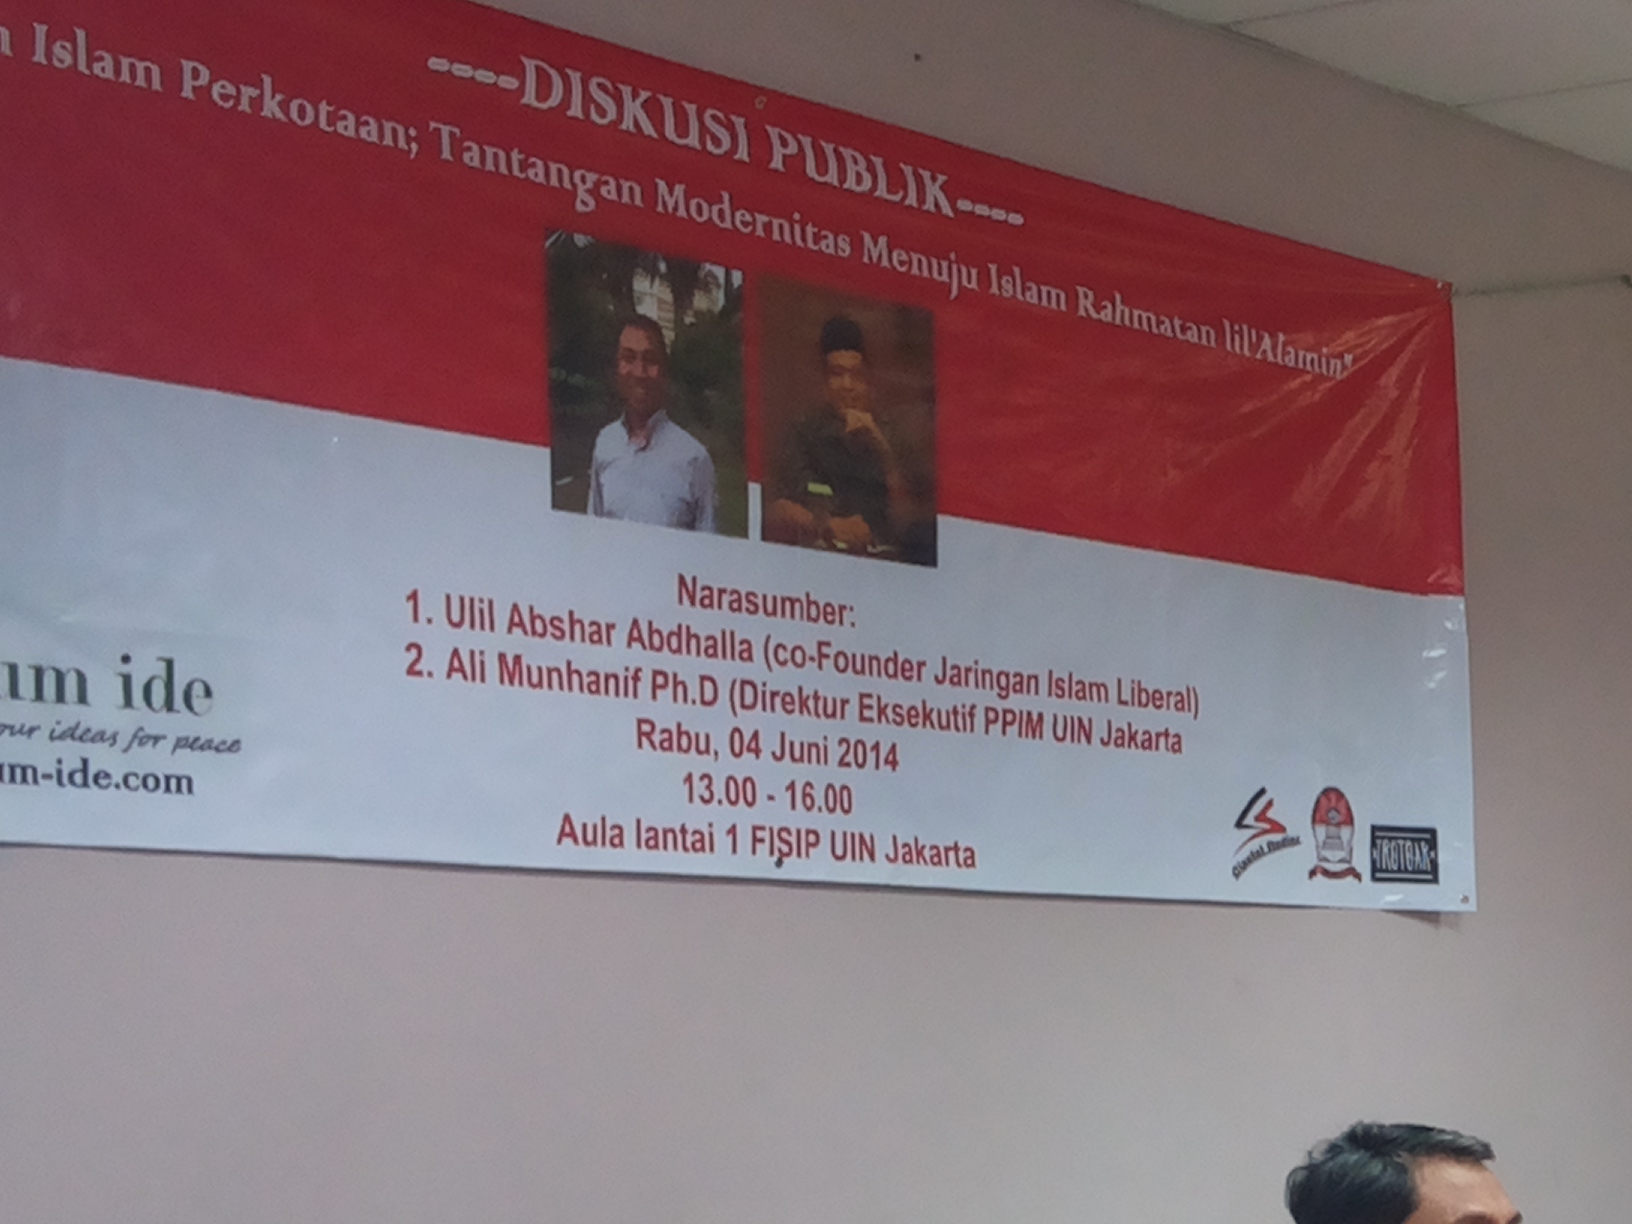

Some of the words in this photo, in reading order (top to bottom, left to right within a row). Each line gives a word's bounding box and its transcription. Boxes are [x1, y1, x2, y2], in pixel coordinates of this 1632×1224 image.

[31, 22, 163, 92] Islam
[180, 58, 419, 157] Perkotaan;
[428, 121, 643, 212] Tantangan
[656, 178, 851, 259] Modernitas
[861, 230, 979, 300] Menuju
[988, 262, 1067, 313] Islam
[1076, 285, 1217, 350] Rahmatan
[677, 572, 856, 628] Narasumber:
[405, 588, 433, 625] 1.
[444, 593, 496, 633] Ulil
[507, 602, 616, 648] Abshar
[626, 617, 754, 664] Abdhalla
[763, 634, 927, 683] (co-Founder
[934, 655, 1040, 699] Jaringan
[1047, 669, 1109, 704] Islam
[1116, 677, 1200, 721] Liberal)
[115, 653, 214, 717] ide
[405, 642, 433, 679] 2.
[445, 647, 486, 684] Ali
[498, 651, 642, 700] Munhanif
[651, 669, 719, 708] Ph.D
[728, 678, 850, 722] (Direktur
[858, 692, 976, 734] Eksekutif
[984, 706, 1045, 741] PPIM
[1051, 714, 1093, 746] UIN
[1100, 721, 1183, 755] Jakarta
[49, 720, 119, 748] ideas
[122, 726, 167, 753] for
[172, 734, 242, 755] peace
[636, 717, 719, 762] Rabu,
[729, 727, 762, 760] 04
[772, 731, 828, 767] Juni
[837, 737, 899, 773] 2014
[683, 772, 757, 808] 13.00
[785, 780, 853, 816] 16.00
[557, 812, 624, 850] Aula
[636, 818, 715, 855] lantai
[726, 823, 738, 856] 1
[751, 825, 820, 860] FISIP
[830, 829, 876, 863] UIN
[885, 834, 976, 870] Jakarta
